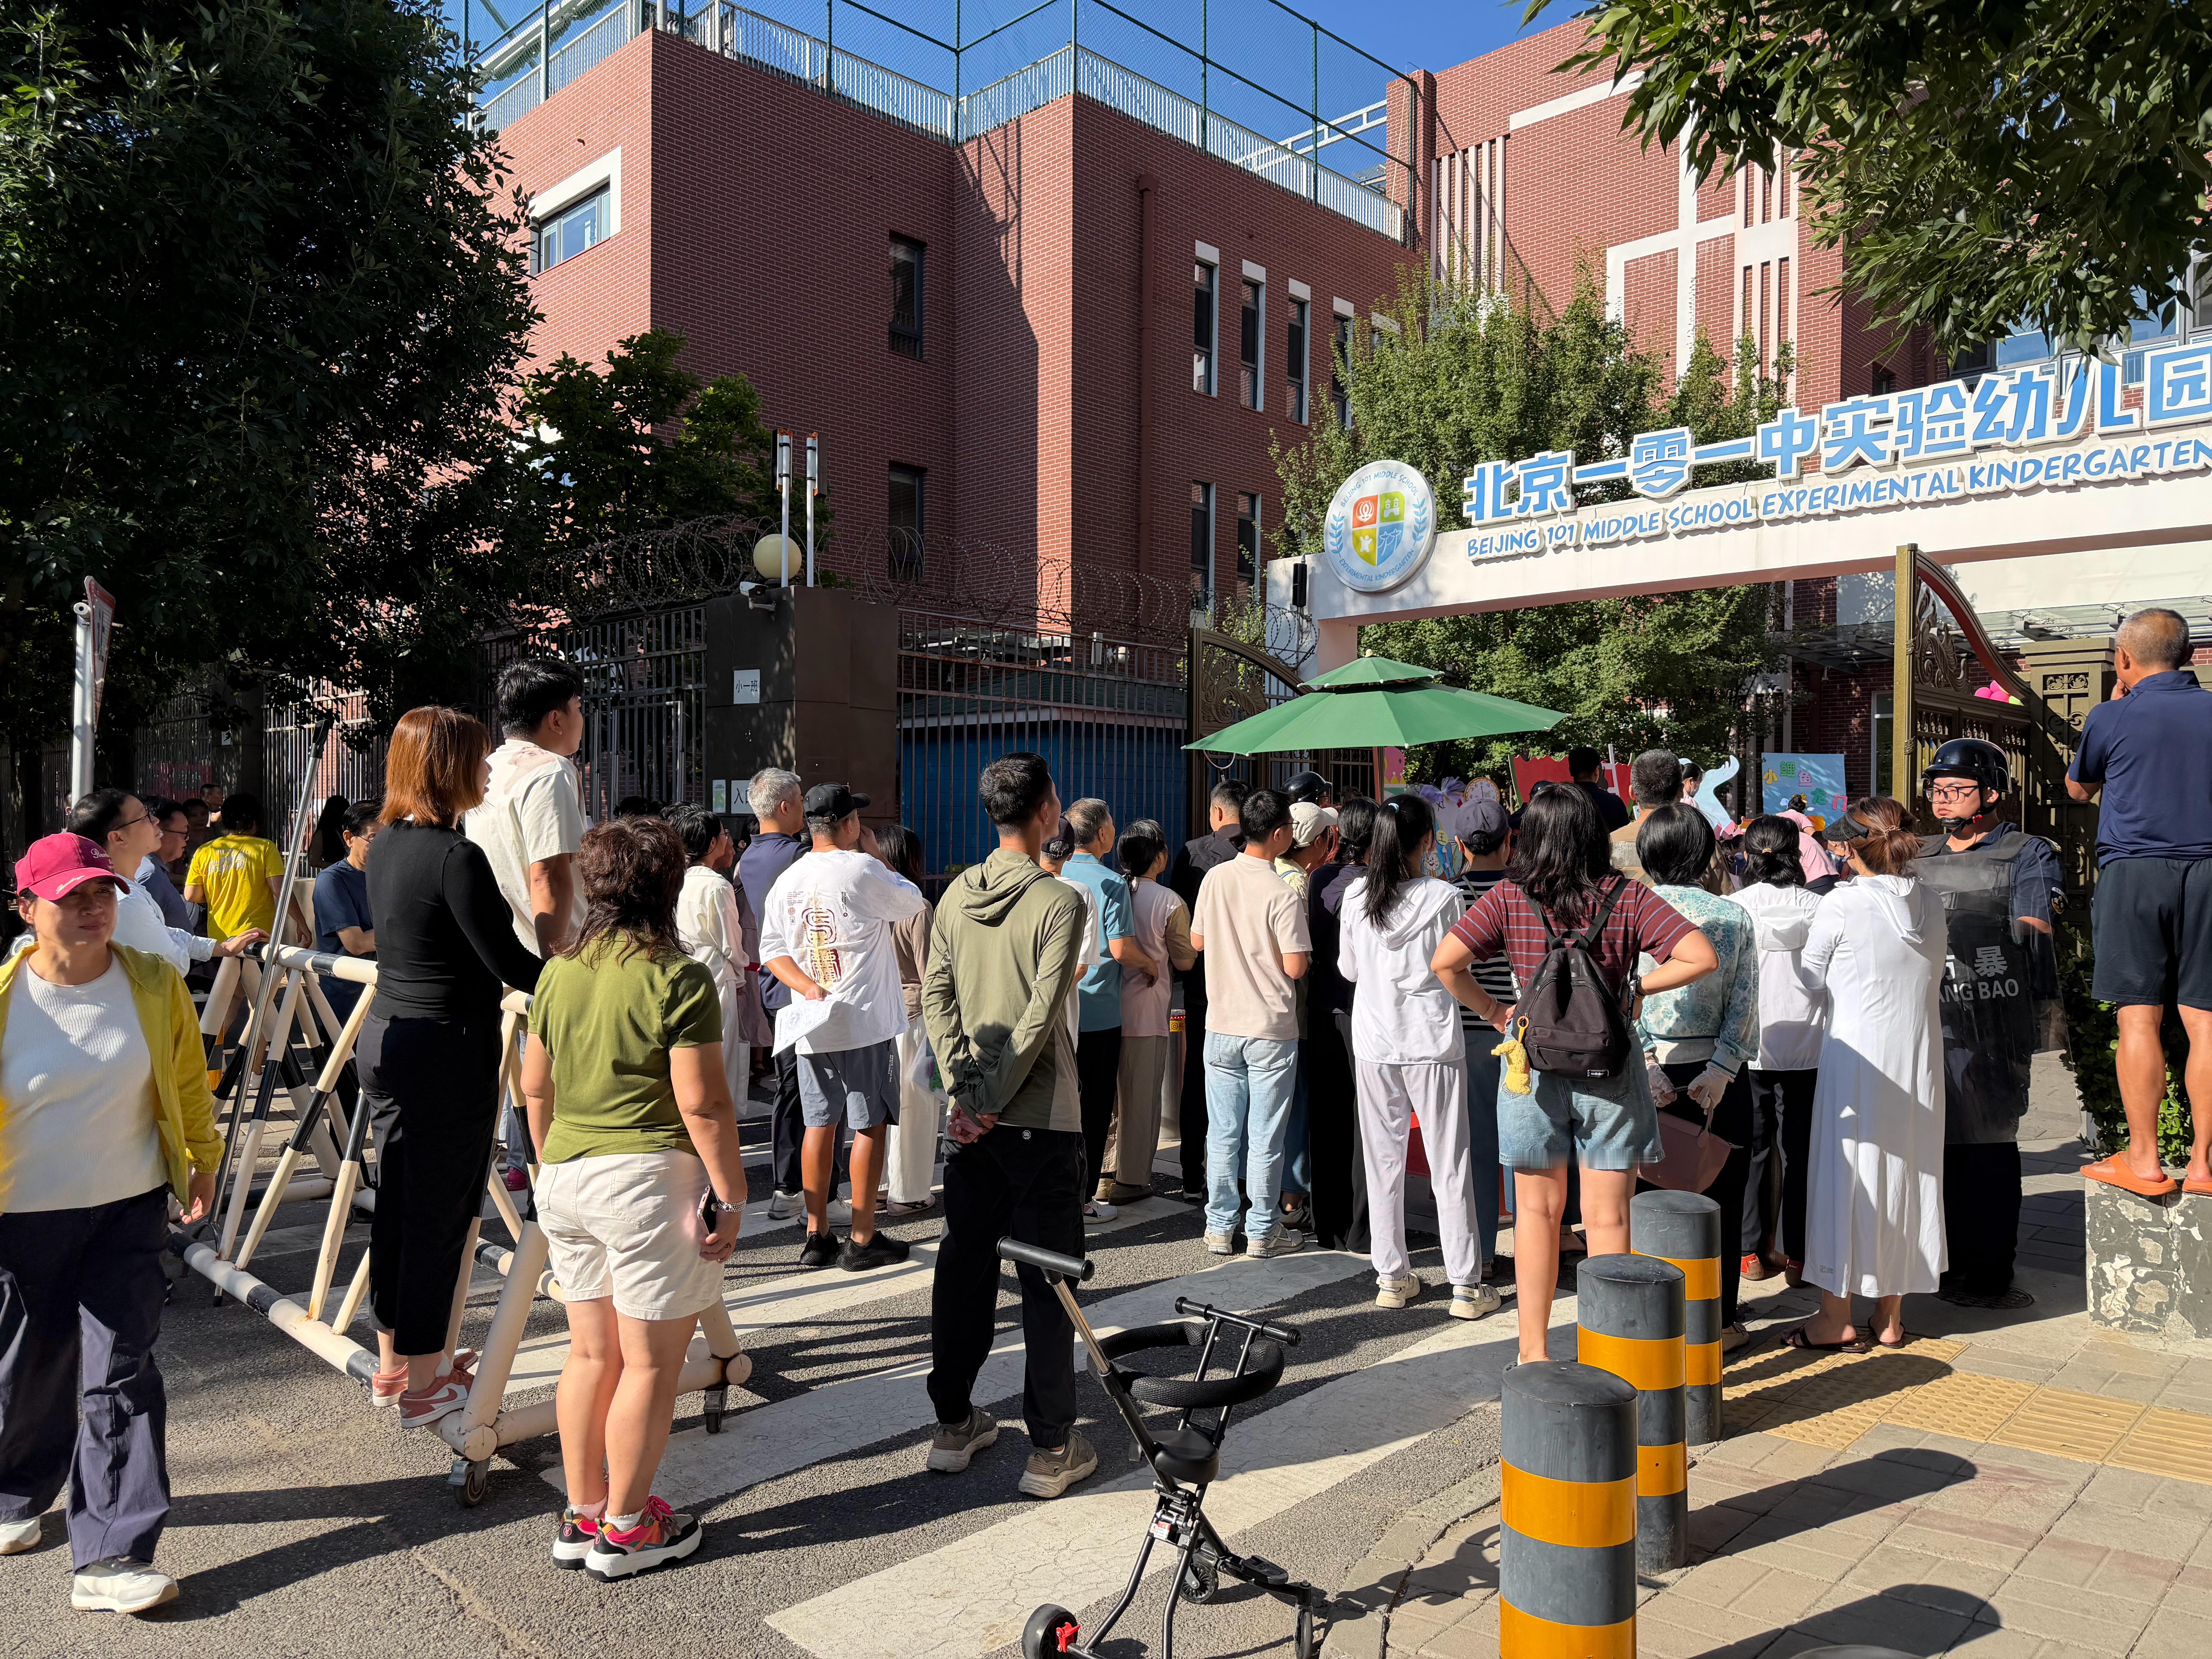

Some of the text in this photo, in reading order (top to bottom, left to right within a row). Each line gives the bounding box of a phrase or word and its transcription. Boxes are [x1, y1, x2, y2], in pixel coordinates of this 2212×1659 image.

[1465, 345, 2212, 520] 北京一零一中实验幼儿园
[1341, 471, 1419, 508] BEIJING 101 MIDDLE SCHOOL
[1468, 439, 2212, 557] BEIJING 101 MIDDLE SCHOOL EXPERIMENTAL KINDERGARTEN
[1339, 549, 1415, 581] EXPERIMENTAL KINDERGARTEN
[736, 679, 758, 693] 小一班
[1977, 979, 2019, 1000] BAO
